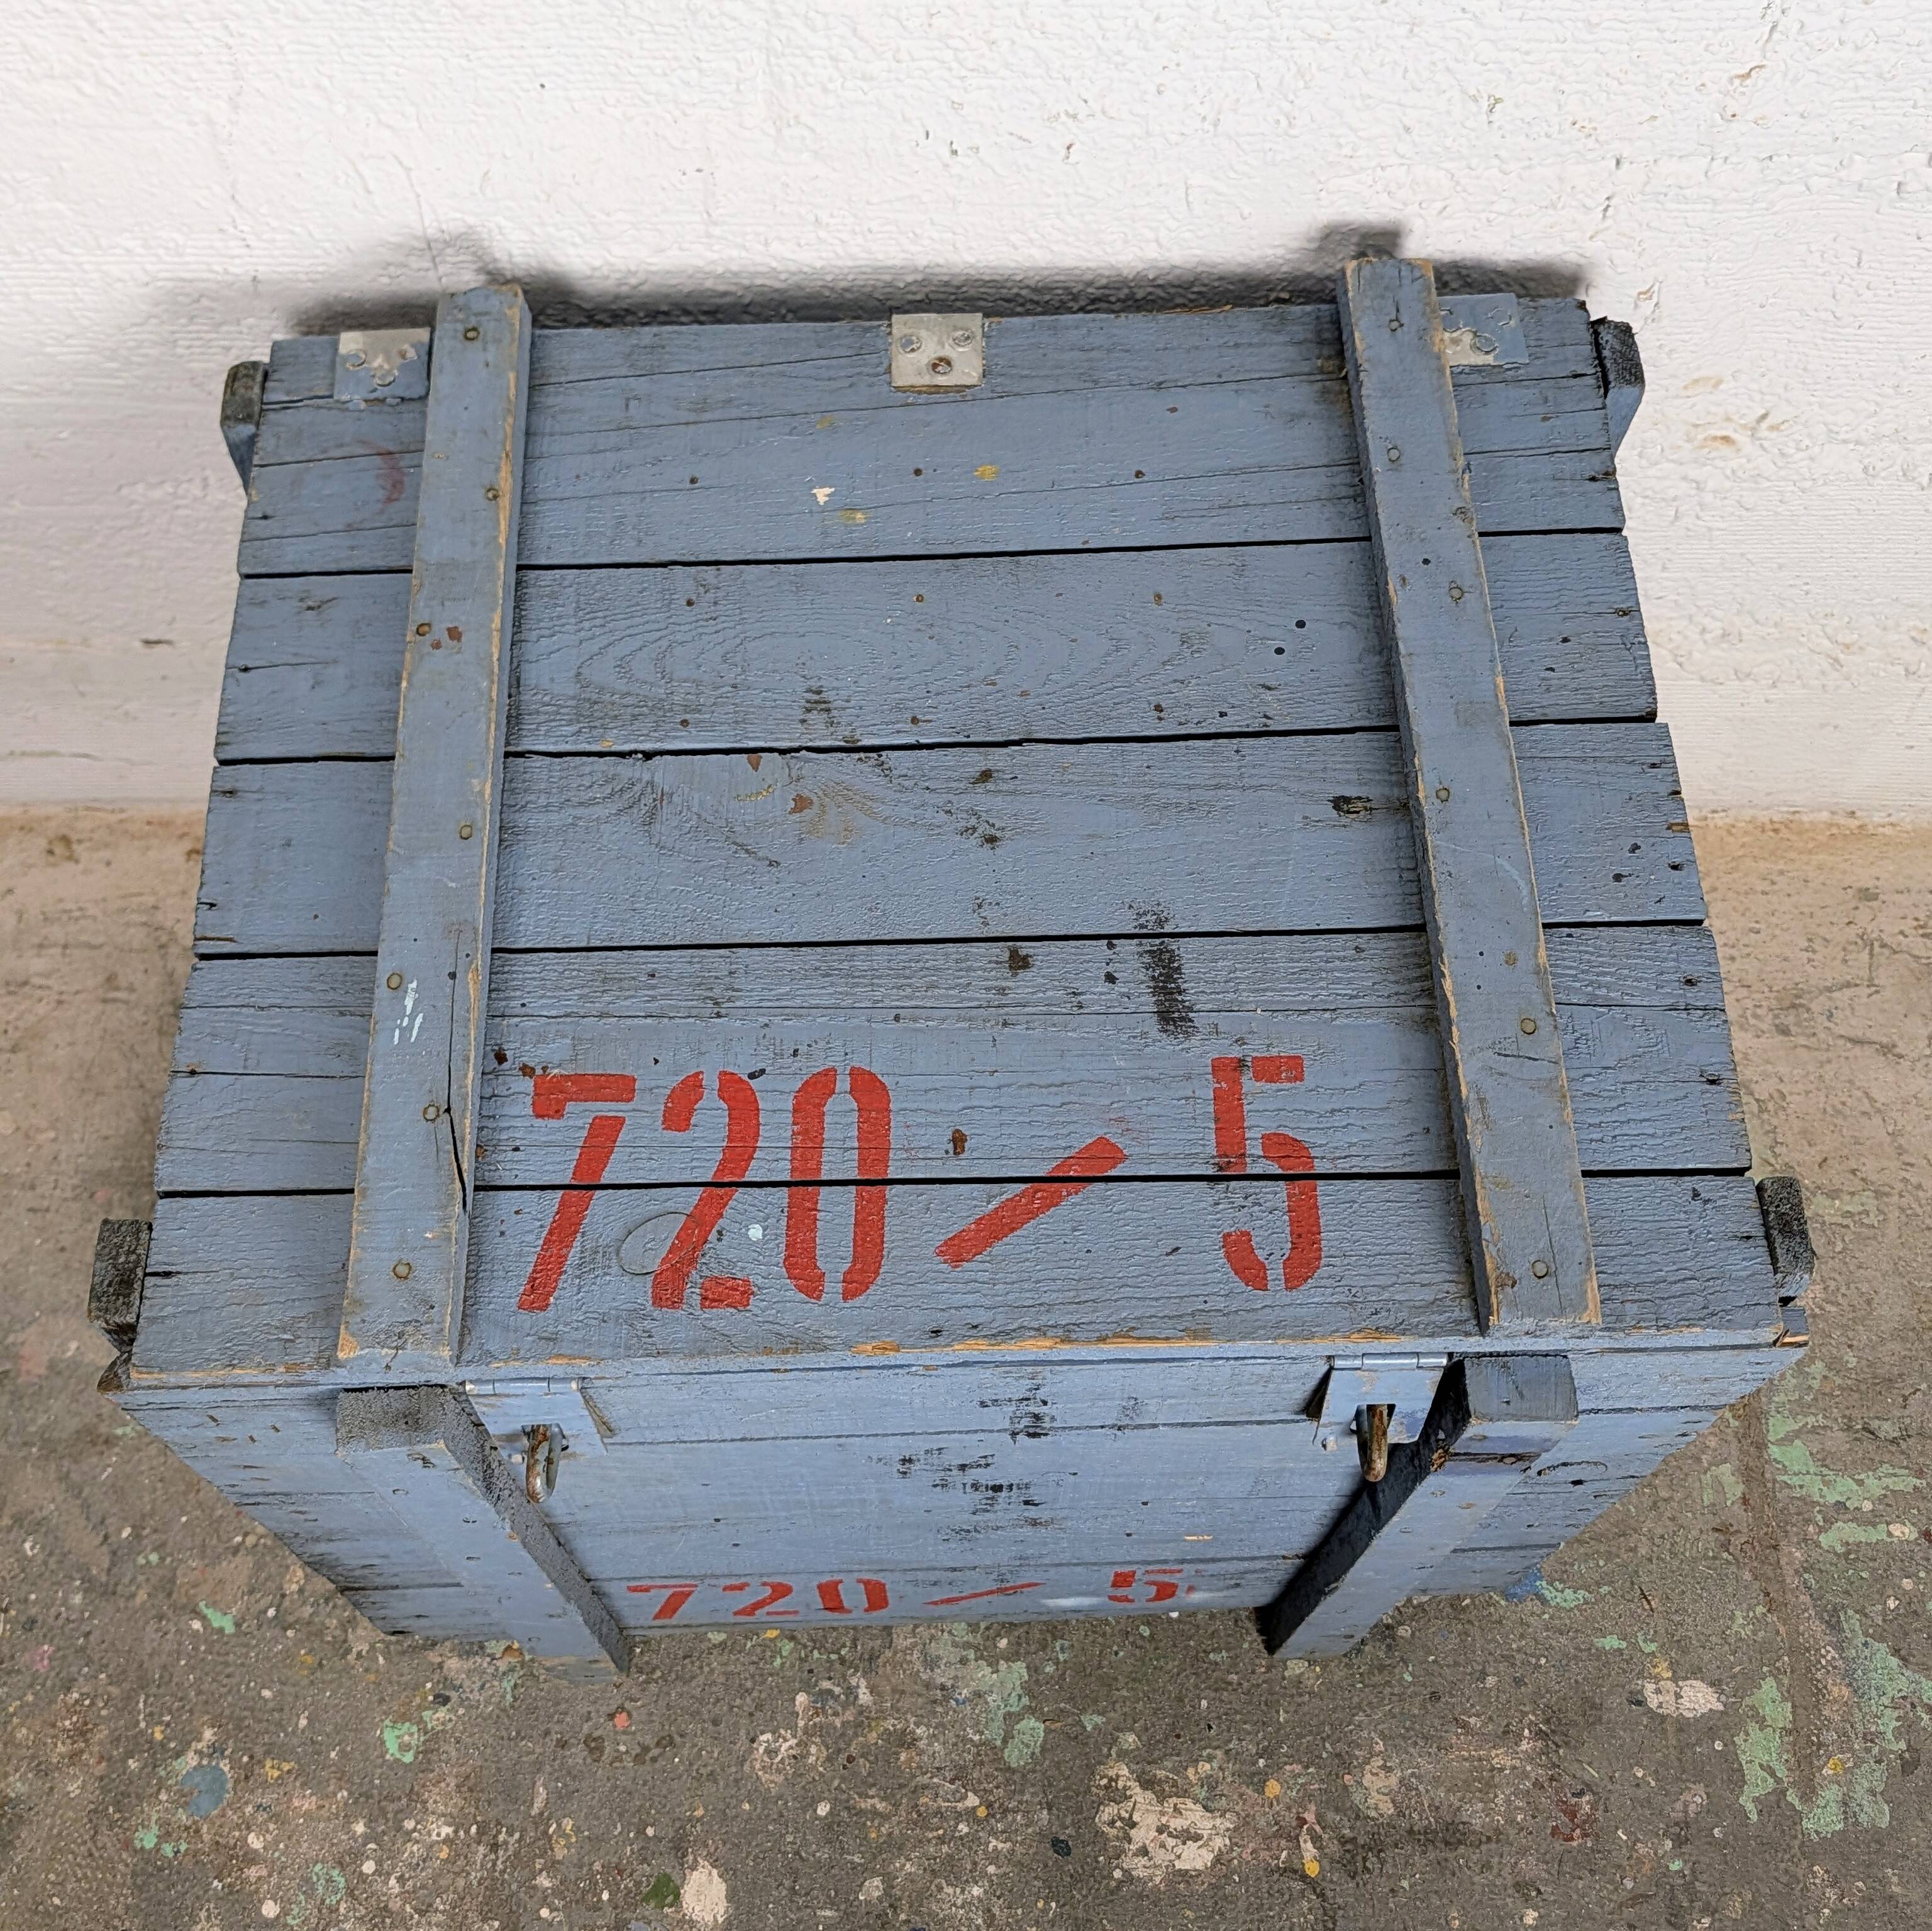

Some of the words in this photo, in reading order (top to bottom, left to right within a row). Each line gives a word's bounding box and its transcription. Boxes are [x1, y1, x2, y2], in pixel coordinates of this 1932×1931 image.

[519, 1066, 892, 1312] 720
[1211, 1055, 1323, 1292] 5
[628, 1578, 889, 1620] 720
[1108, 1569, 1183, 1603] 5
